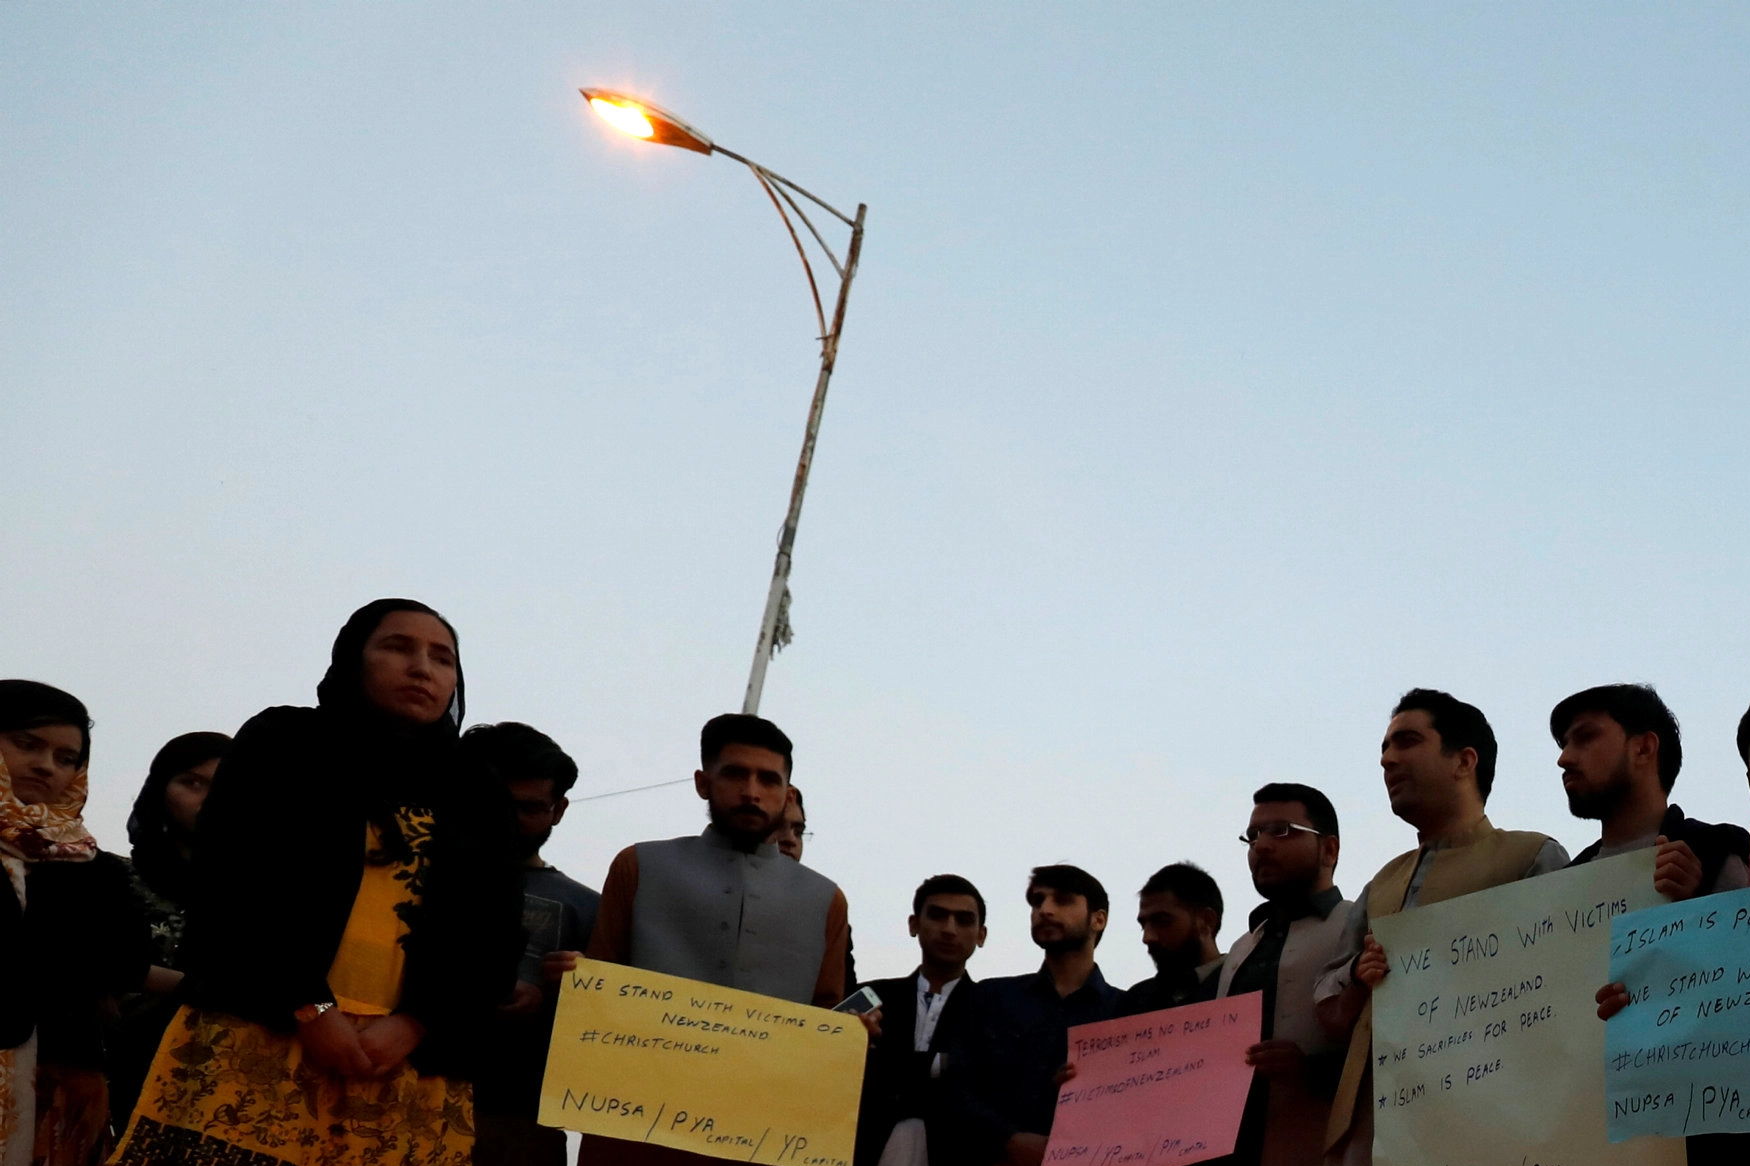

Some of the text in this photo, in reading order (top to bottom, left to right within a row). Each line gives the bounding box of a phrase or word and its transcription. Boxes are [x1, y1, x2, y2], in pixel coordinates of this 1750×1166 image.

[1699, 911, 1716, 929] IS
[1400, 948, 1431, 974] WE
[1450, 933, 1499, 966] STAND
[1565, 899, 1628, 933] VICTIMS
[1627, 985, 1650, 1007] WE
[1669, 967, 1725, 997] STAND
[572, 972, 843, 1034] WE STAND WITH VICTIMS OF
[1418, 997, 1439, 1023] OF
[1656, 1006, 1680, 1027] OF
[662, 1012, 770, 1040] NEWZEALAND
[1075, 1034, 1128, 1060] TERRORISM
[1135, 1027, 1153, 1040] HAS
[1159, 1024, 1174, 1035] NO
[1222, 1013, 1238, 1025] IN
[1393, 1051, 1408, 1062] WE
[1418, 1032, 1472, 1058] SACRIFICES
[1484, 1021, 1507, 1041] FOR
[580, 1030, 719, 1054] #CHRISTCHURCH
[1129, 1048, 1160, 1064] ISLAM
[1393, 1083, 1425, 1106] ISLAM
[1441, 1075, 1452, 1091] IS
[1615, 1092, 1674, 1119] NUPSA
[1702, 1086, 1740, 1120] PYA
[562, 1088, 644, 1116] NUPSA
[671, 1111, 715, 1131] PYA
[706, 1134, 754, 1147] CAPITAL
[777, 1134, 808, 1160] YP
[1048, 1146, 1089, 1160] NUPSA
